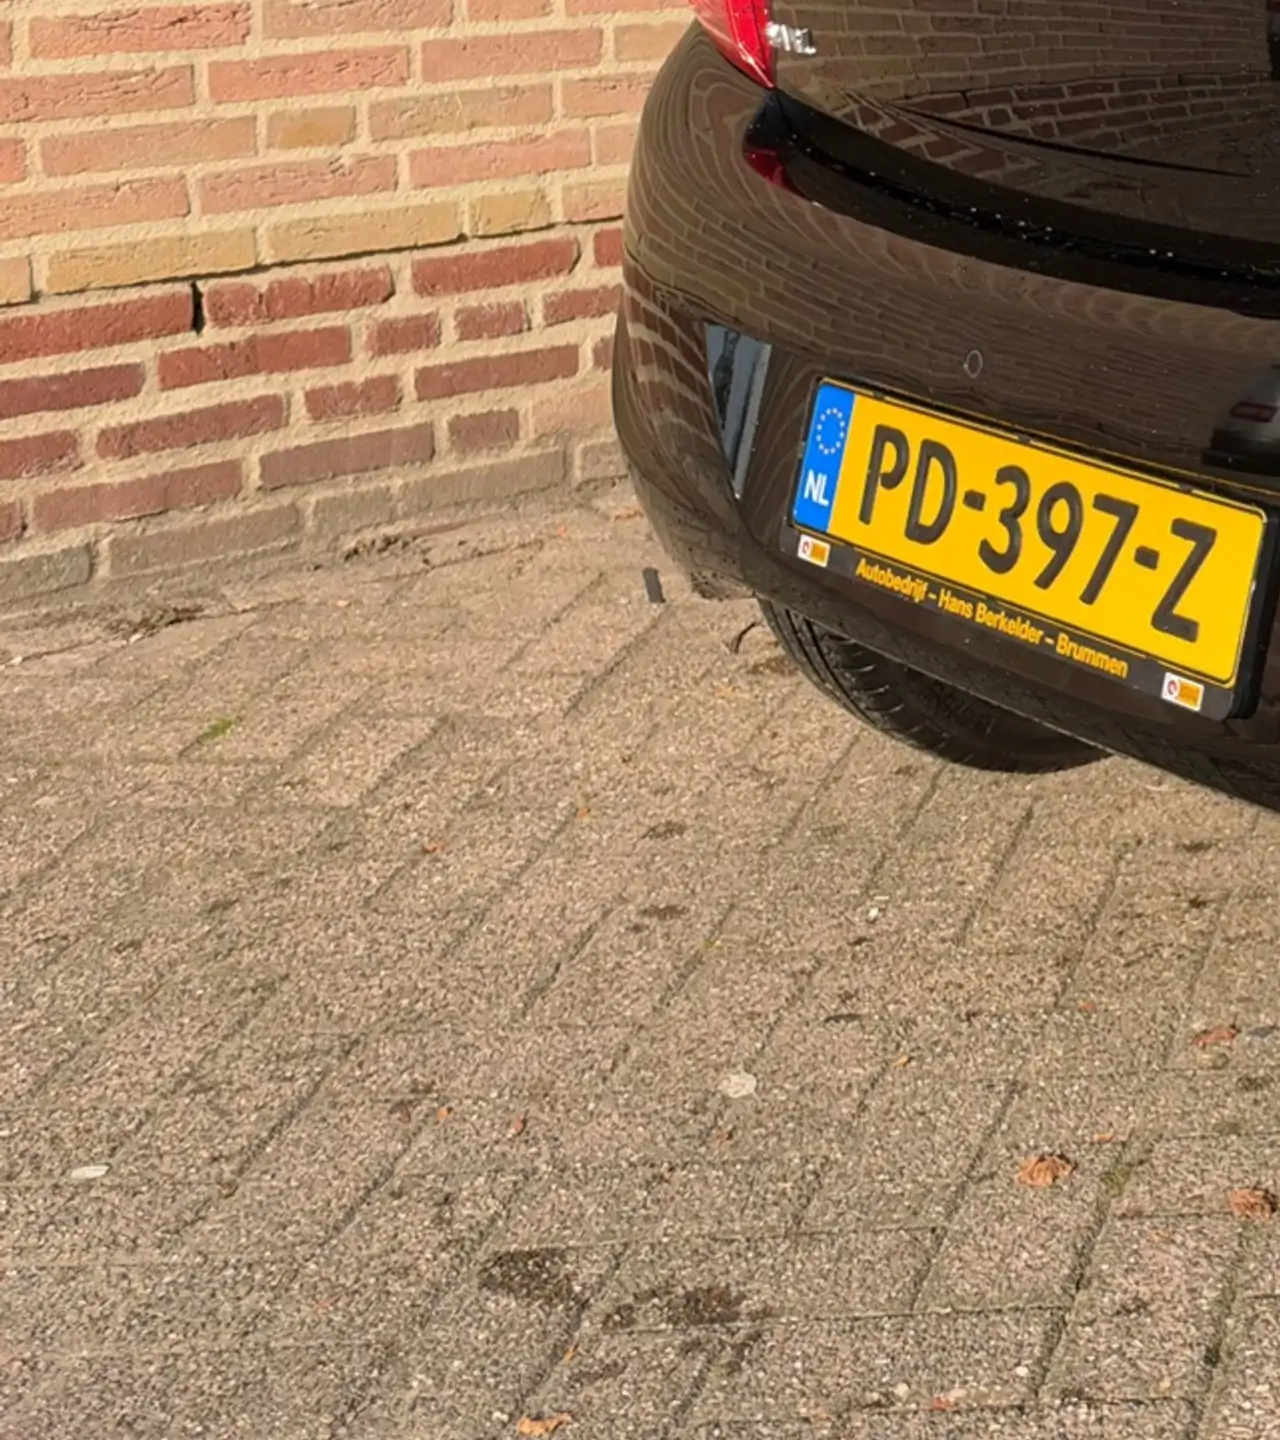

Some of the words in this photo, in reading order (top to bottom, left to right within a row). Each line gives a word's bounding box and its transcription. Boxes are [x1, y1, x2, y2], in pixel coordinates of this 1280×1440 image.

[804, 469, 829, 506] NL
[858, 423, 1218, 644] PD-397-Z
[855, 558, 929, 603] Autobedrijf
[938, 588, 973, 620] Hans
[975, 601, 1044, 645] Berkelder
[1056, 632, 1128, 679] Brummen
